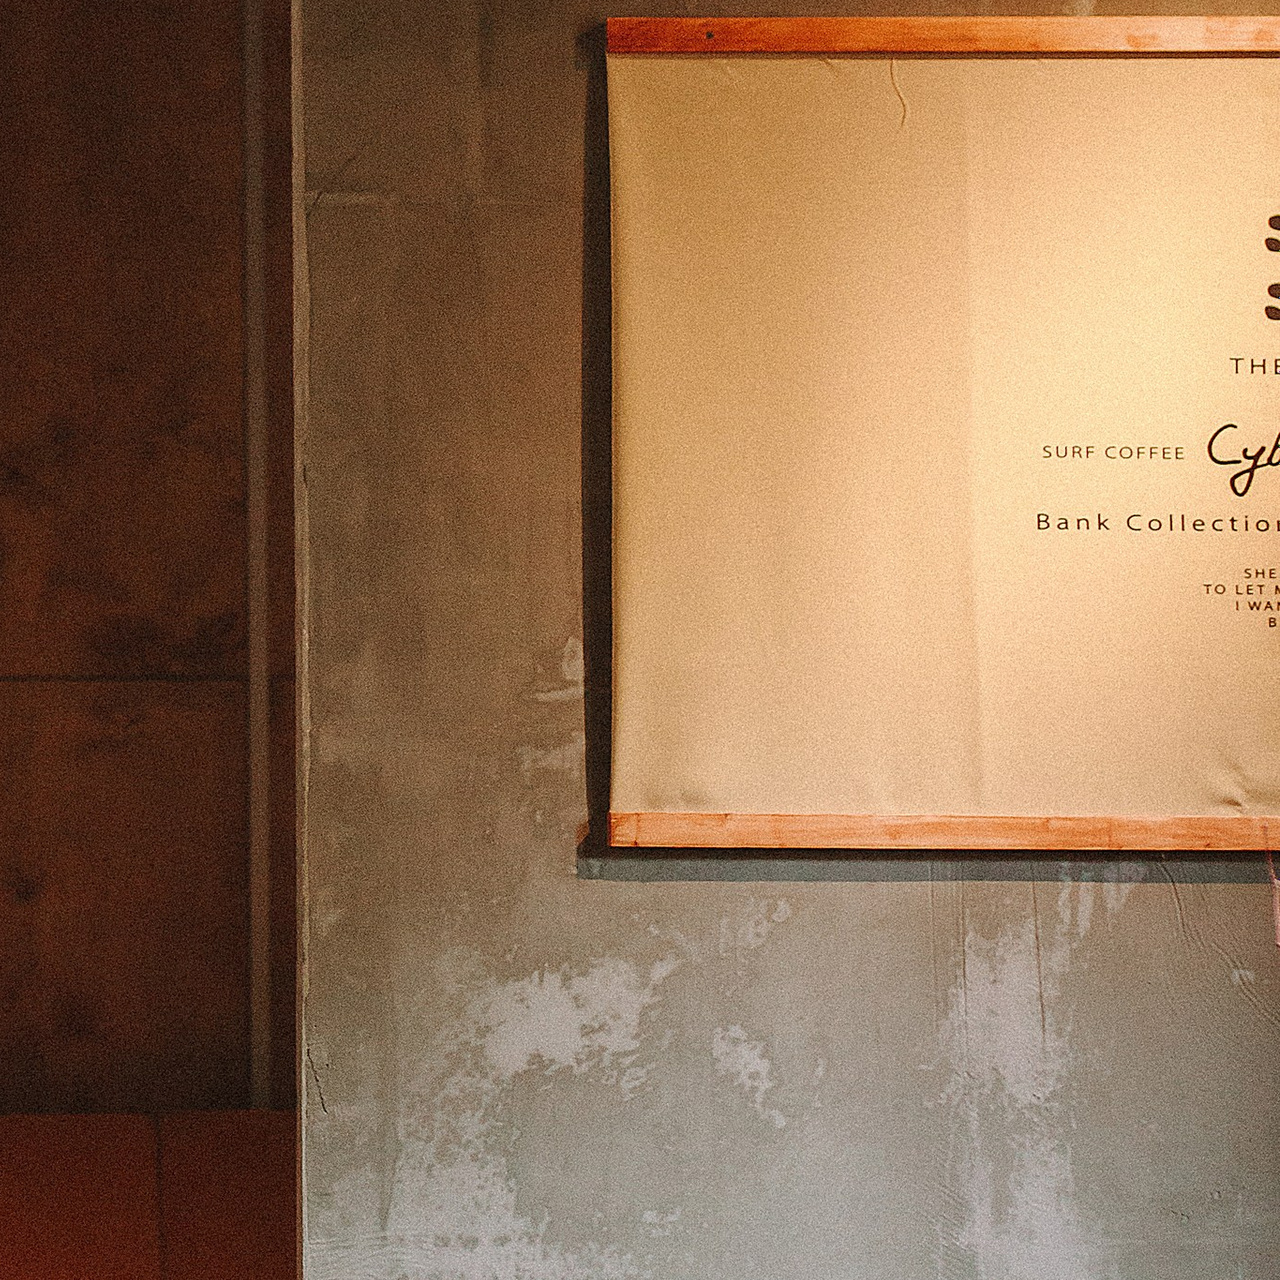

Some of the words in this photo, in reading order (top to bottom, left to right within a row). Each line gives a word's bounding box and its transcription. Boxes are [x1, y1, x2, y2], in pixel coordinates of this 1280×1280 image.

[1042, 445, 1095, 459] SURF
[1104, 446, 1185, 460] COFFEE
[1036, 513, 1110, 531] Bank
[1126, 514, 1280, 532] Collectio
[1244, 568, 1277, 579] SHE
[1203, 584, 1227, 595] TO
[1235, 584, 1265, 595] LET
